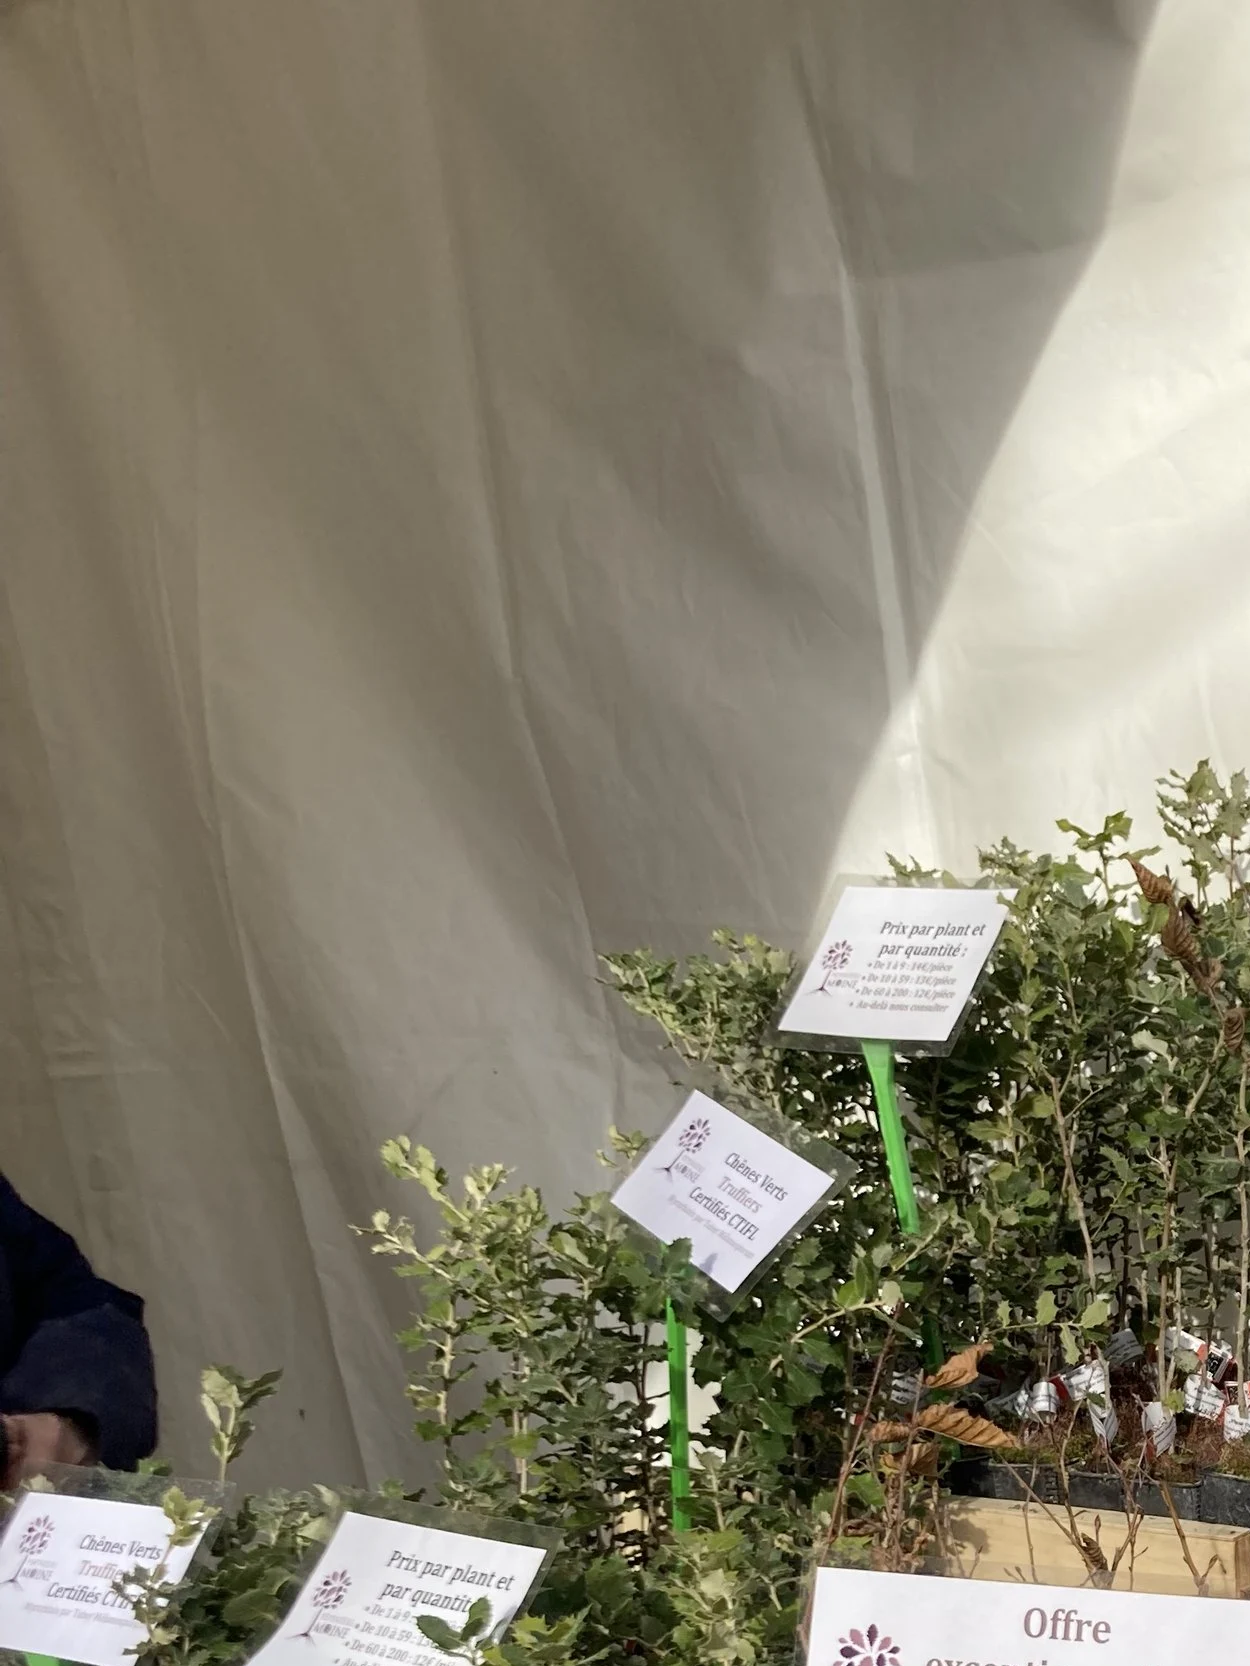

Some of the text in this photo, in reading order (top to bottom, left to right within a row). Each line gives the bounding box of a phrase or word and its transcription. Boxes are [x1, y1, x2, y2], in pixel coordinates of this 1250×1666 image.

[880, 921, 986, 940] Prix par plant et
[878, 943, 962, 959] par quantité
[724, 1152, 760, 1186] Chênes
[760, 1173, 788, 1202] Verts
[689, 1187, 730, 1222] Certifiés
[727, 1212, 760, 1241] CTIFL
[79, 1534, 163, 1561] Chênes Verts
[386, 1550, 515, 1591] Prix par plant et
[47, 1582, 100, 1604] Certifiés
[379, 1581, 472, 1612] par quantit
[1023, 1606, 1112, 1644] Offre
